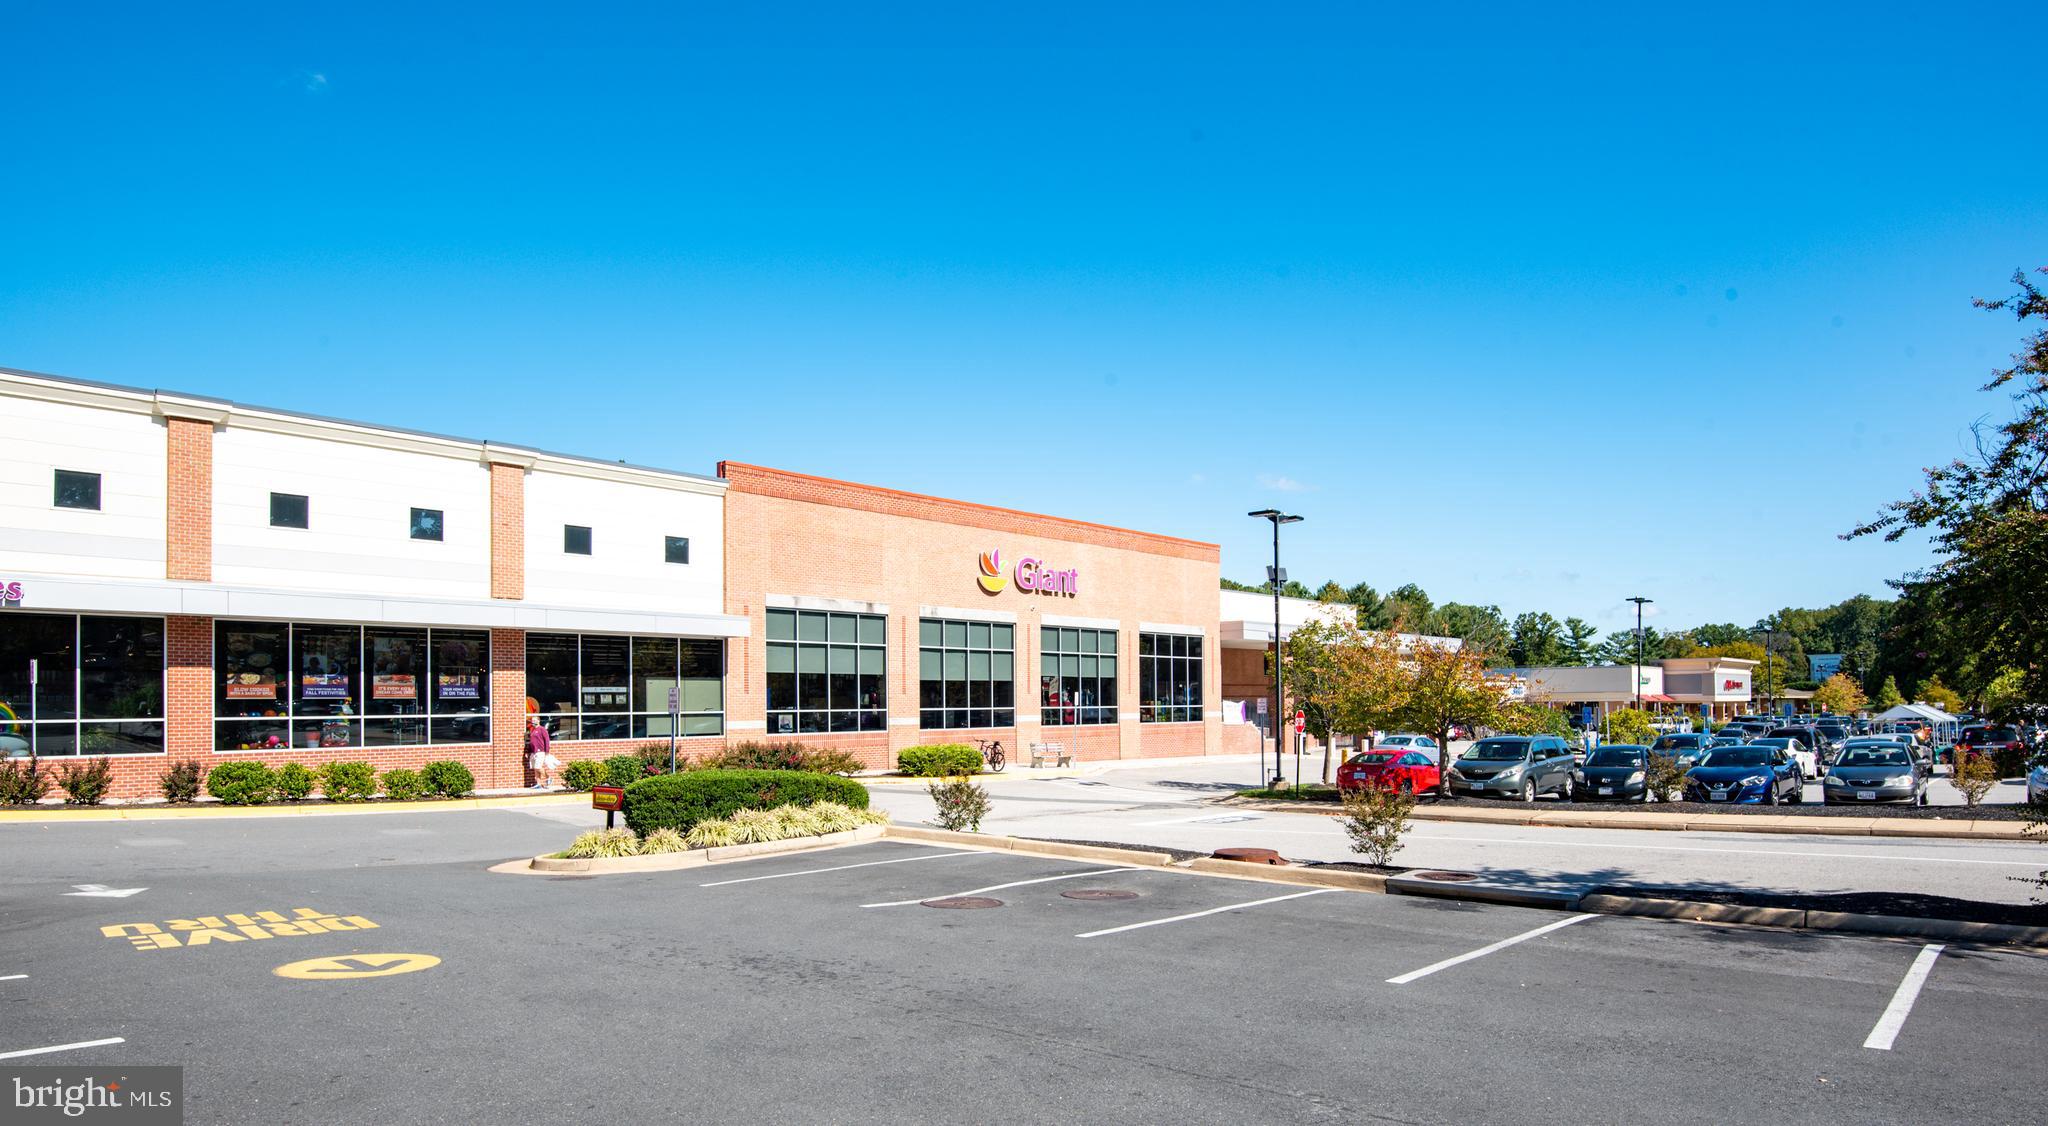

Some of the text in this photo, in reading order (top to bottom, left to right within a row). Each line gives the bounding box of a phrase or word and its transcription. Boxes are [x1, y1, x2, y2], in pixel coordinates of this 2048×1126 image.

[1015, 556, 1079, 594] Giant
[99, 907, 338, 938] THRU
[127, 915, 381, 951] DRIVE
